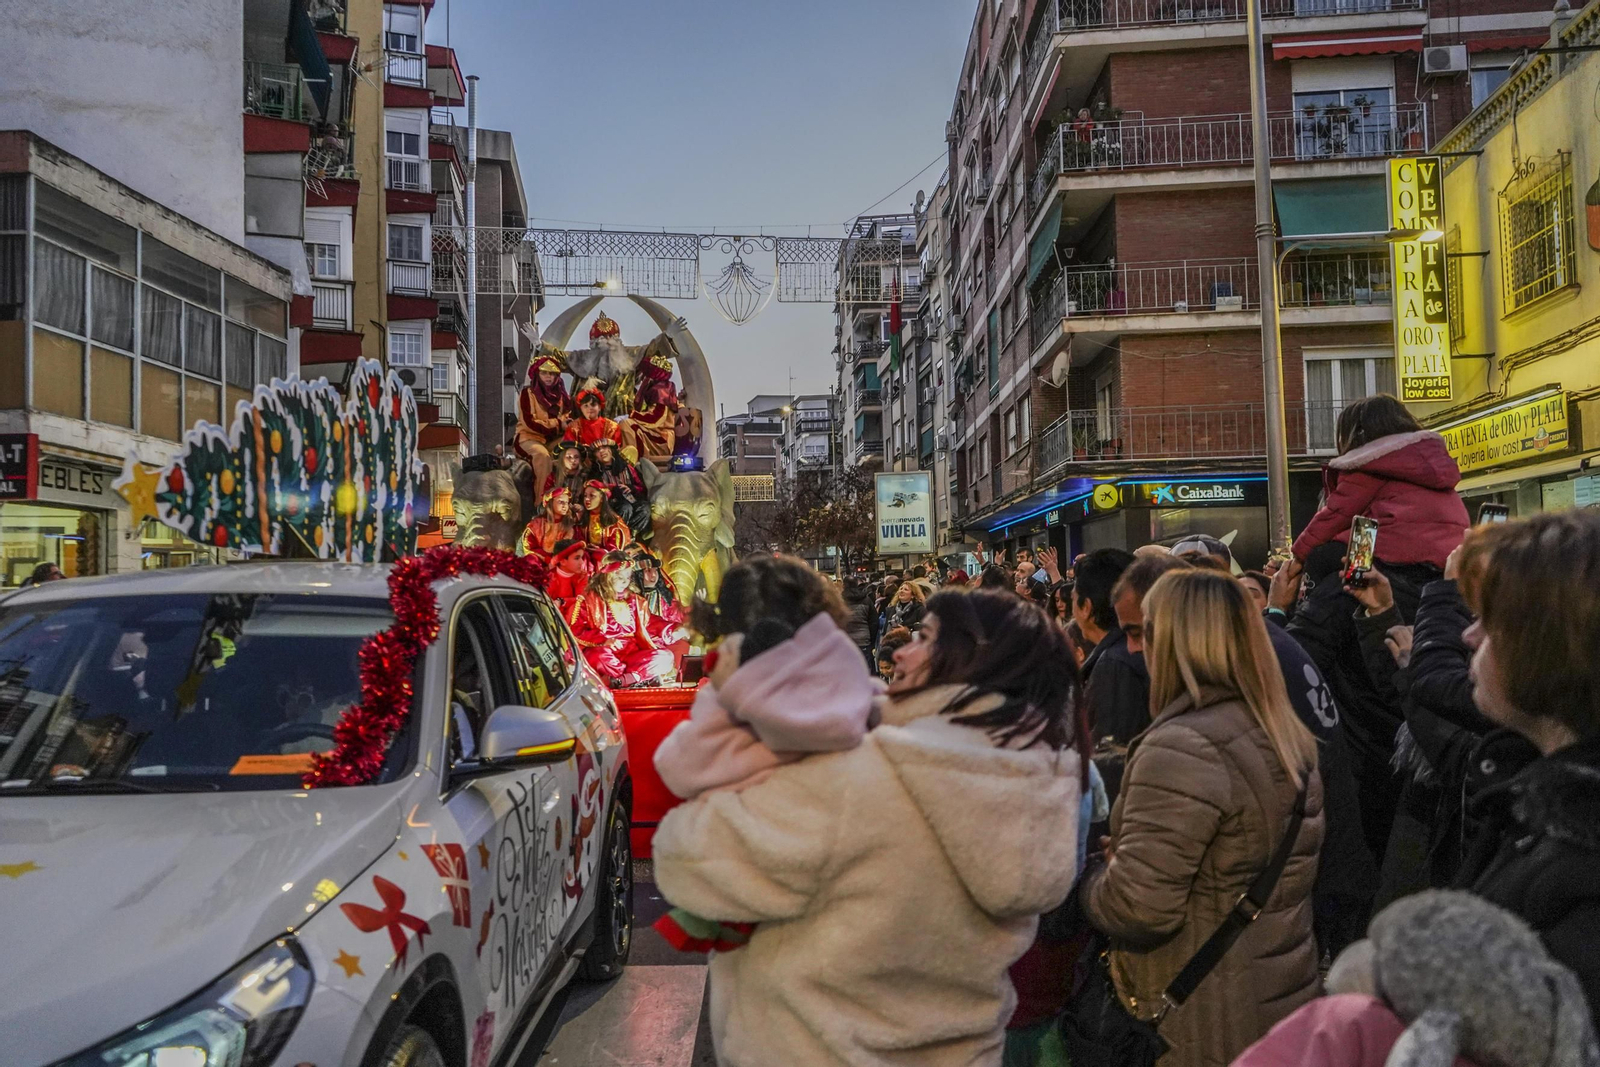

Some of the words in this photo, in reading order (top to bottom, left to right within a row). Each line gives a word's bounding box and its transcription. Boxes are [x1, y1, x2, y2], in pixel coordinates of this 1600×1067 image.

[1418, 163, 1442, 292] VENTA
[1398, 164, 1419, 318] COMPRA
[1425, 298, 1444, 316] de
[1403, 326, 1434, 346] ORO
[1437, 331, 1444, 351] y
[1403, 354, 1448, 374] PLATA
[1405, 388, 1424, 398] low
[1426, 387, 1450, 397] cost
[1460, 422, 1488, 447] VENTA
[1489, 415, 1499, 439] de
[1500, 412, 1521, 437] ORO
[1523, 414, 1529, 437] y
[1530, 397, 1565, 428] PLATA
[1487, 444, 1501, 460] low
[1502, 438, 1520, 456] cost
[38, 464, 103, 495] EBLES
[1177, 484, 1245, 499] CaixaBank
